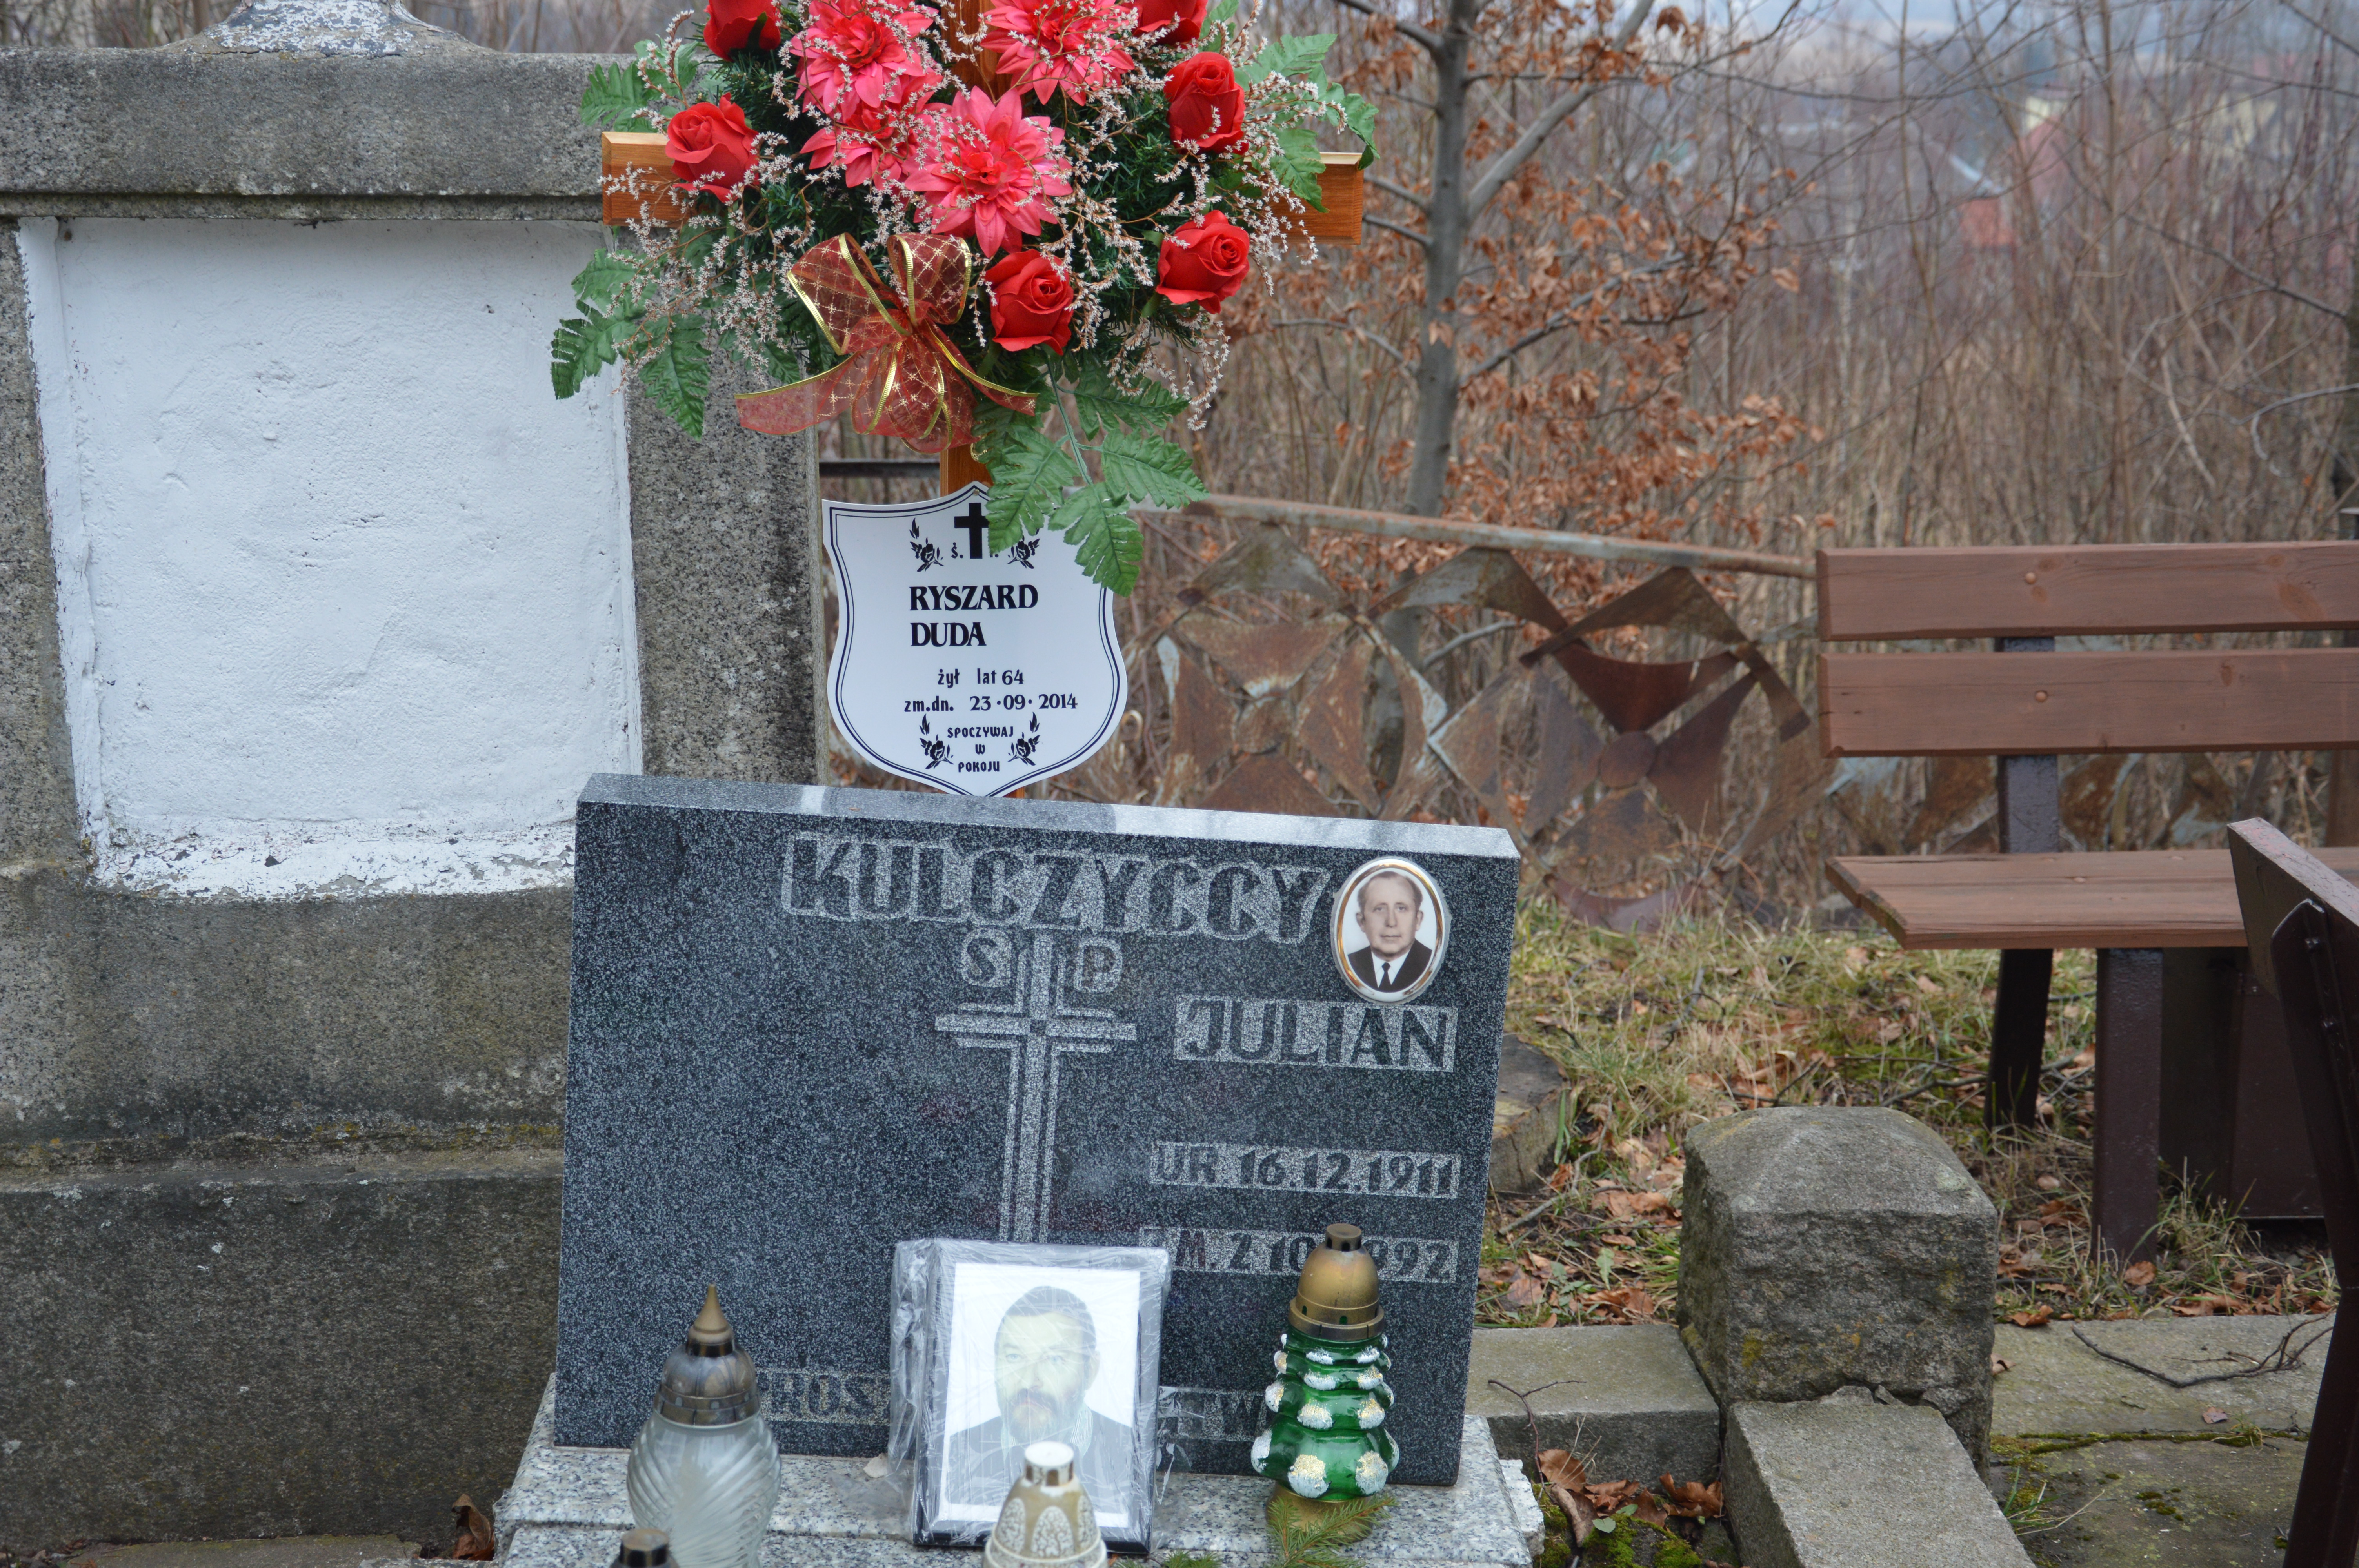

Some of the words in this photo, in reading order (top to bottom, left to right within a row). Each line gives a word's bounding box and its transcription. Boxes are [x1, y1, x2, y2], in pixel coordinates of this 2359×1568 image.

[909, 584, 1038, 611] RYSZARD
[910, 622, 987, 647] DUDA
[937, 668, 960, 689] żył
[977, 668, 997, 684] lat
[1001, 669, 1024, 685] 64
[947, 726, 1014, 738] SPOCZYWAJ
[975, 744, 986, 755] W
[958, 761, 1000, 773] POKOJU
[786, 834, 1329, 941] KULCZYCCY
[1178, 998, 1453, 1068] JULIAN
